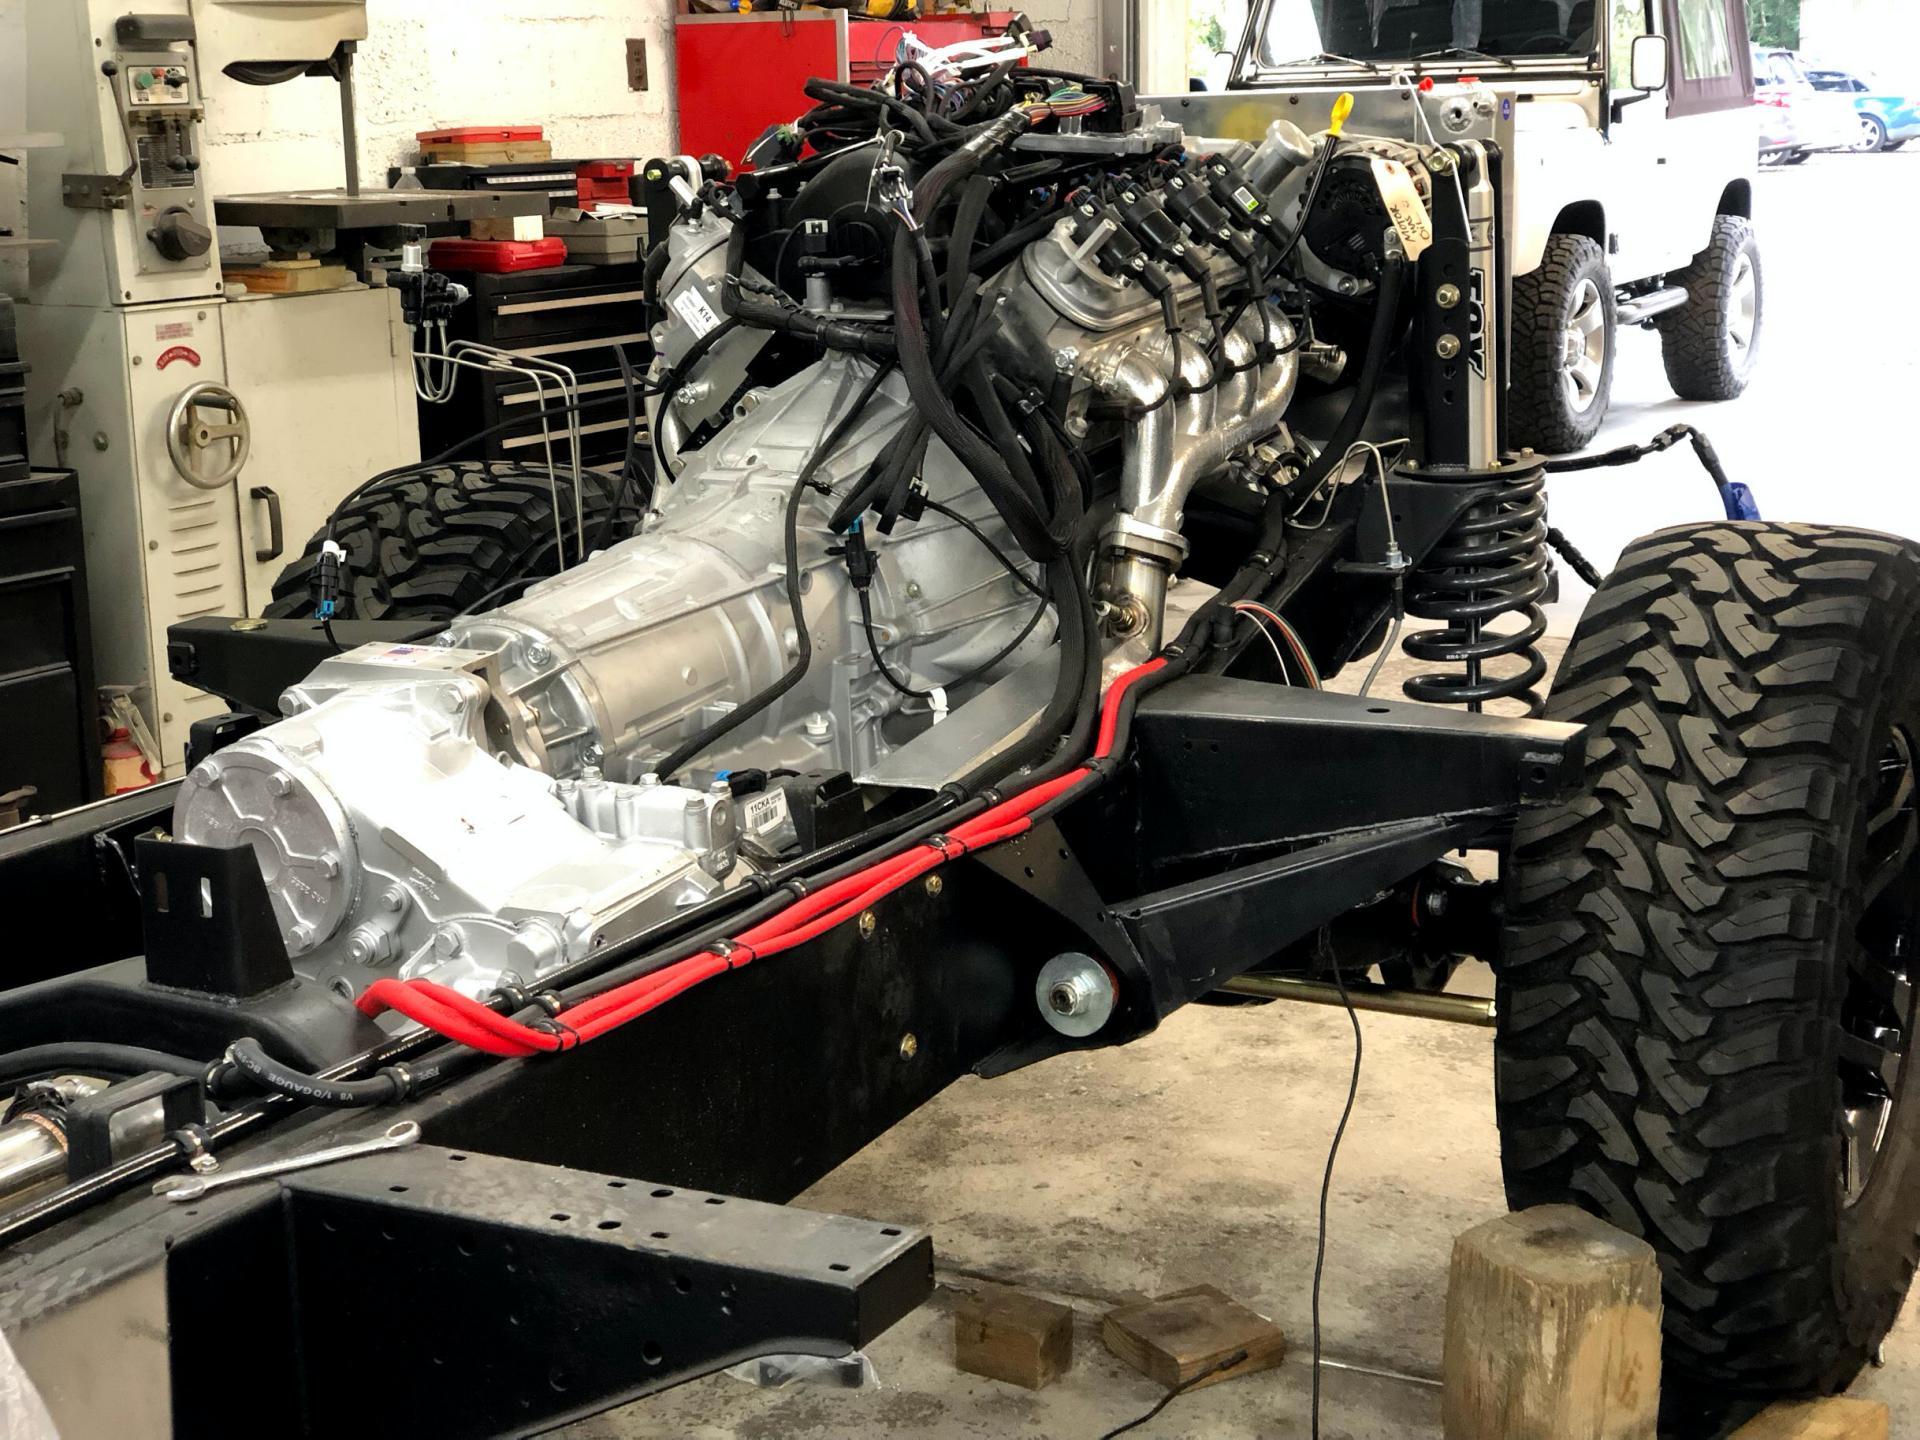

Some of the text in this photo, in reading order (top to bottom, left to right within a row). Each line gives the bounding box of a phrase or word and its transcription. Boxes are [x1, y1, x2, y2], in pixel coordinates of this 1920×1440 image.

[1390, 204, 1416, 242] MOTOR
[698, 306, 712, 322] K14
[750, 797, 770, 814] 11CKA
[268, 1072, 312, 1095] GAUGE
